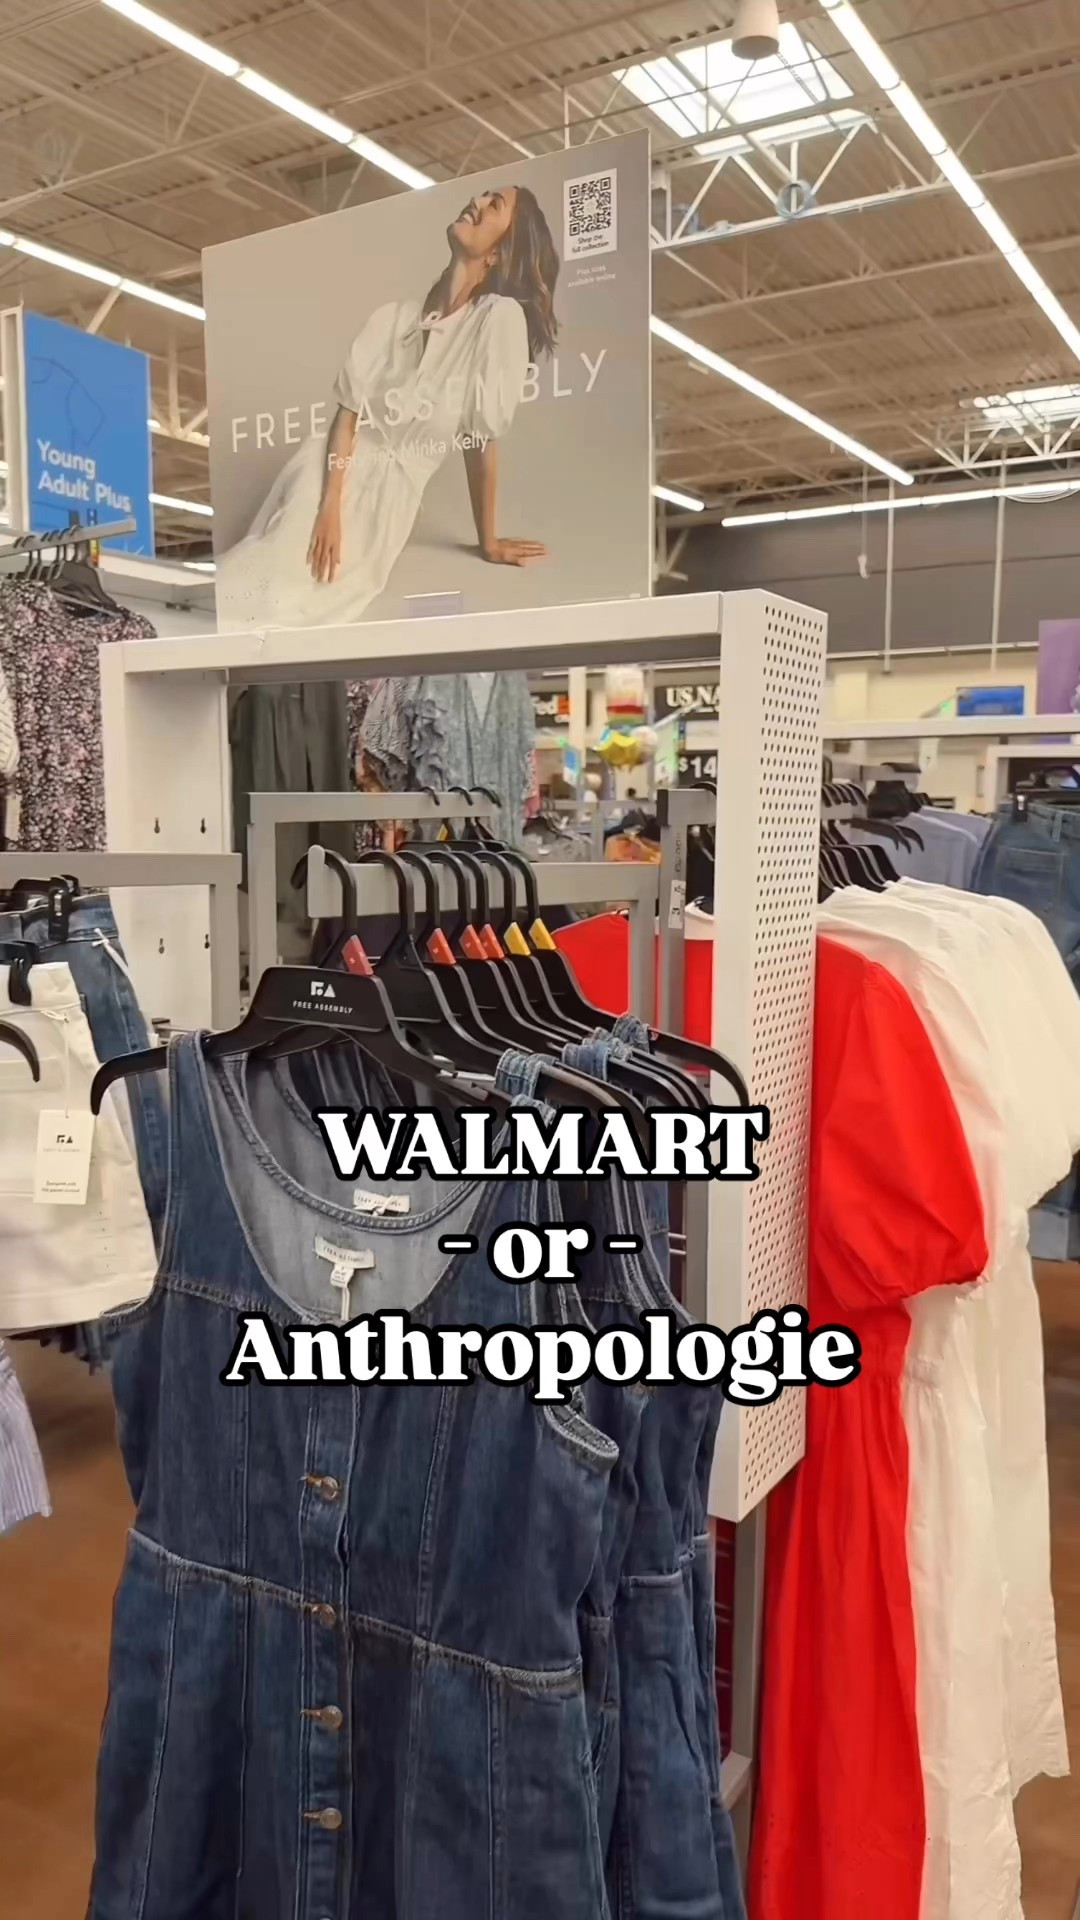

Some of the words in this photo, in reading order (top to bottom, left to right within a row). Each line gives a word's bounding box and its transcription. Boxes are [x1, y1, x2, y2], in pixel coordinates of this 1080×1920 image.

[231, 401, 327, 452] FREE
[355, 349, 607, 432] ASSEMBLY
[37, 438, 96, 480] Young
[401, 437, 446, 459] Minka
[452, 430, 489, 453] Kelly
[38, 470, 90, 501] Adult
[95, 482, 132, 512] Plus
[666, 686, 693, 708] US
[293, 1000, 312, 1010] FREE
[314, 1003, 354, 1014] ASSEMBLY
